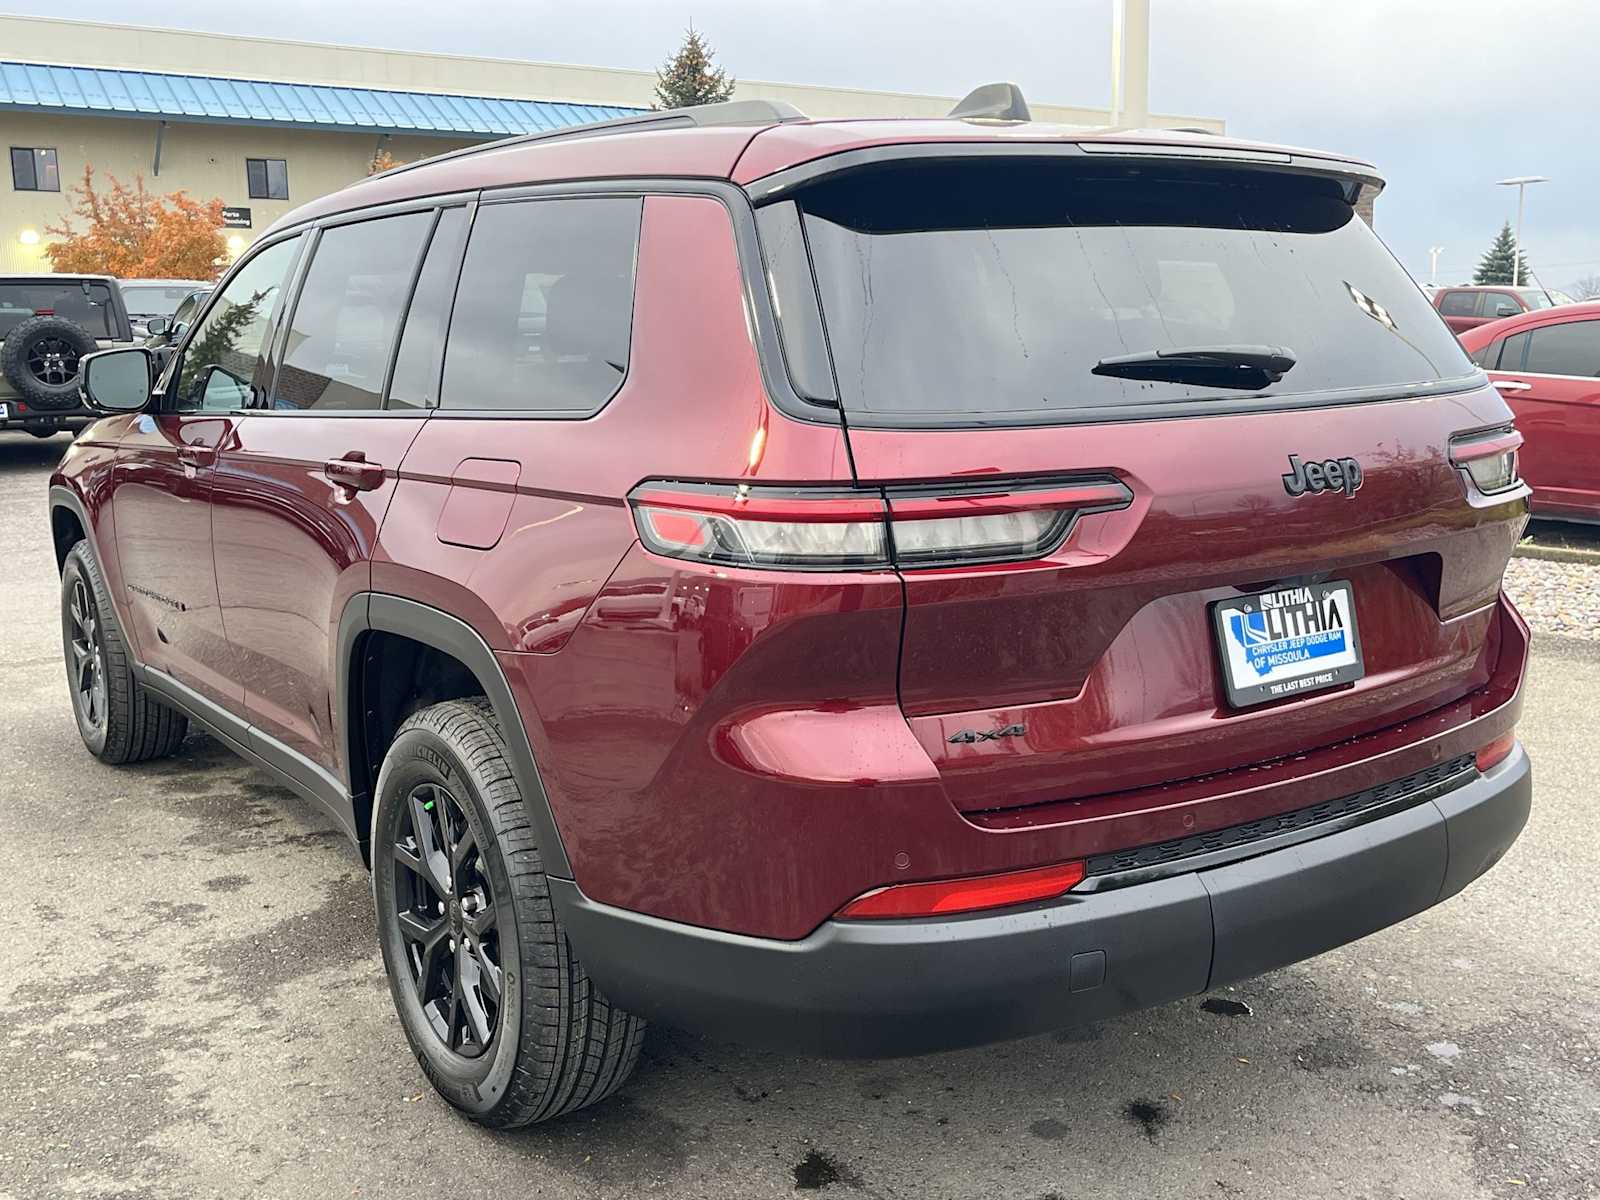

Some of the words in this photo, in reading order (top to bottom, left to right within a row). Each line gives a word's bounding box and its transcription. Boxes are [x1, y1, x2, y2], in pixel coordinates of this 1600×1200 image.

[1281, 454, 1363, 498] Jeep
[1272, 587, 1314, 608] LITHIA
[1265, 599, 1343, 641] LITHIA
[1252, 642, 1288, 656] CHRYSLER
[1289, 639, 1305, 650] JEEP
[1306, 635, 1328, 646] DODGE
[1329, 632, 1341, 641] RAM
[1254, 657, 1267, 669] OF
[1268, 649, 1310, 666] MISSOULA
[1270, 684, 1283, 695] THE
[1284, 681, 1298, 691] LAST
[1299, 677, 1315, 688] BEST
[1315, 673, 1333, 685] PRICE
